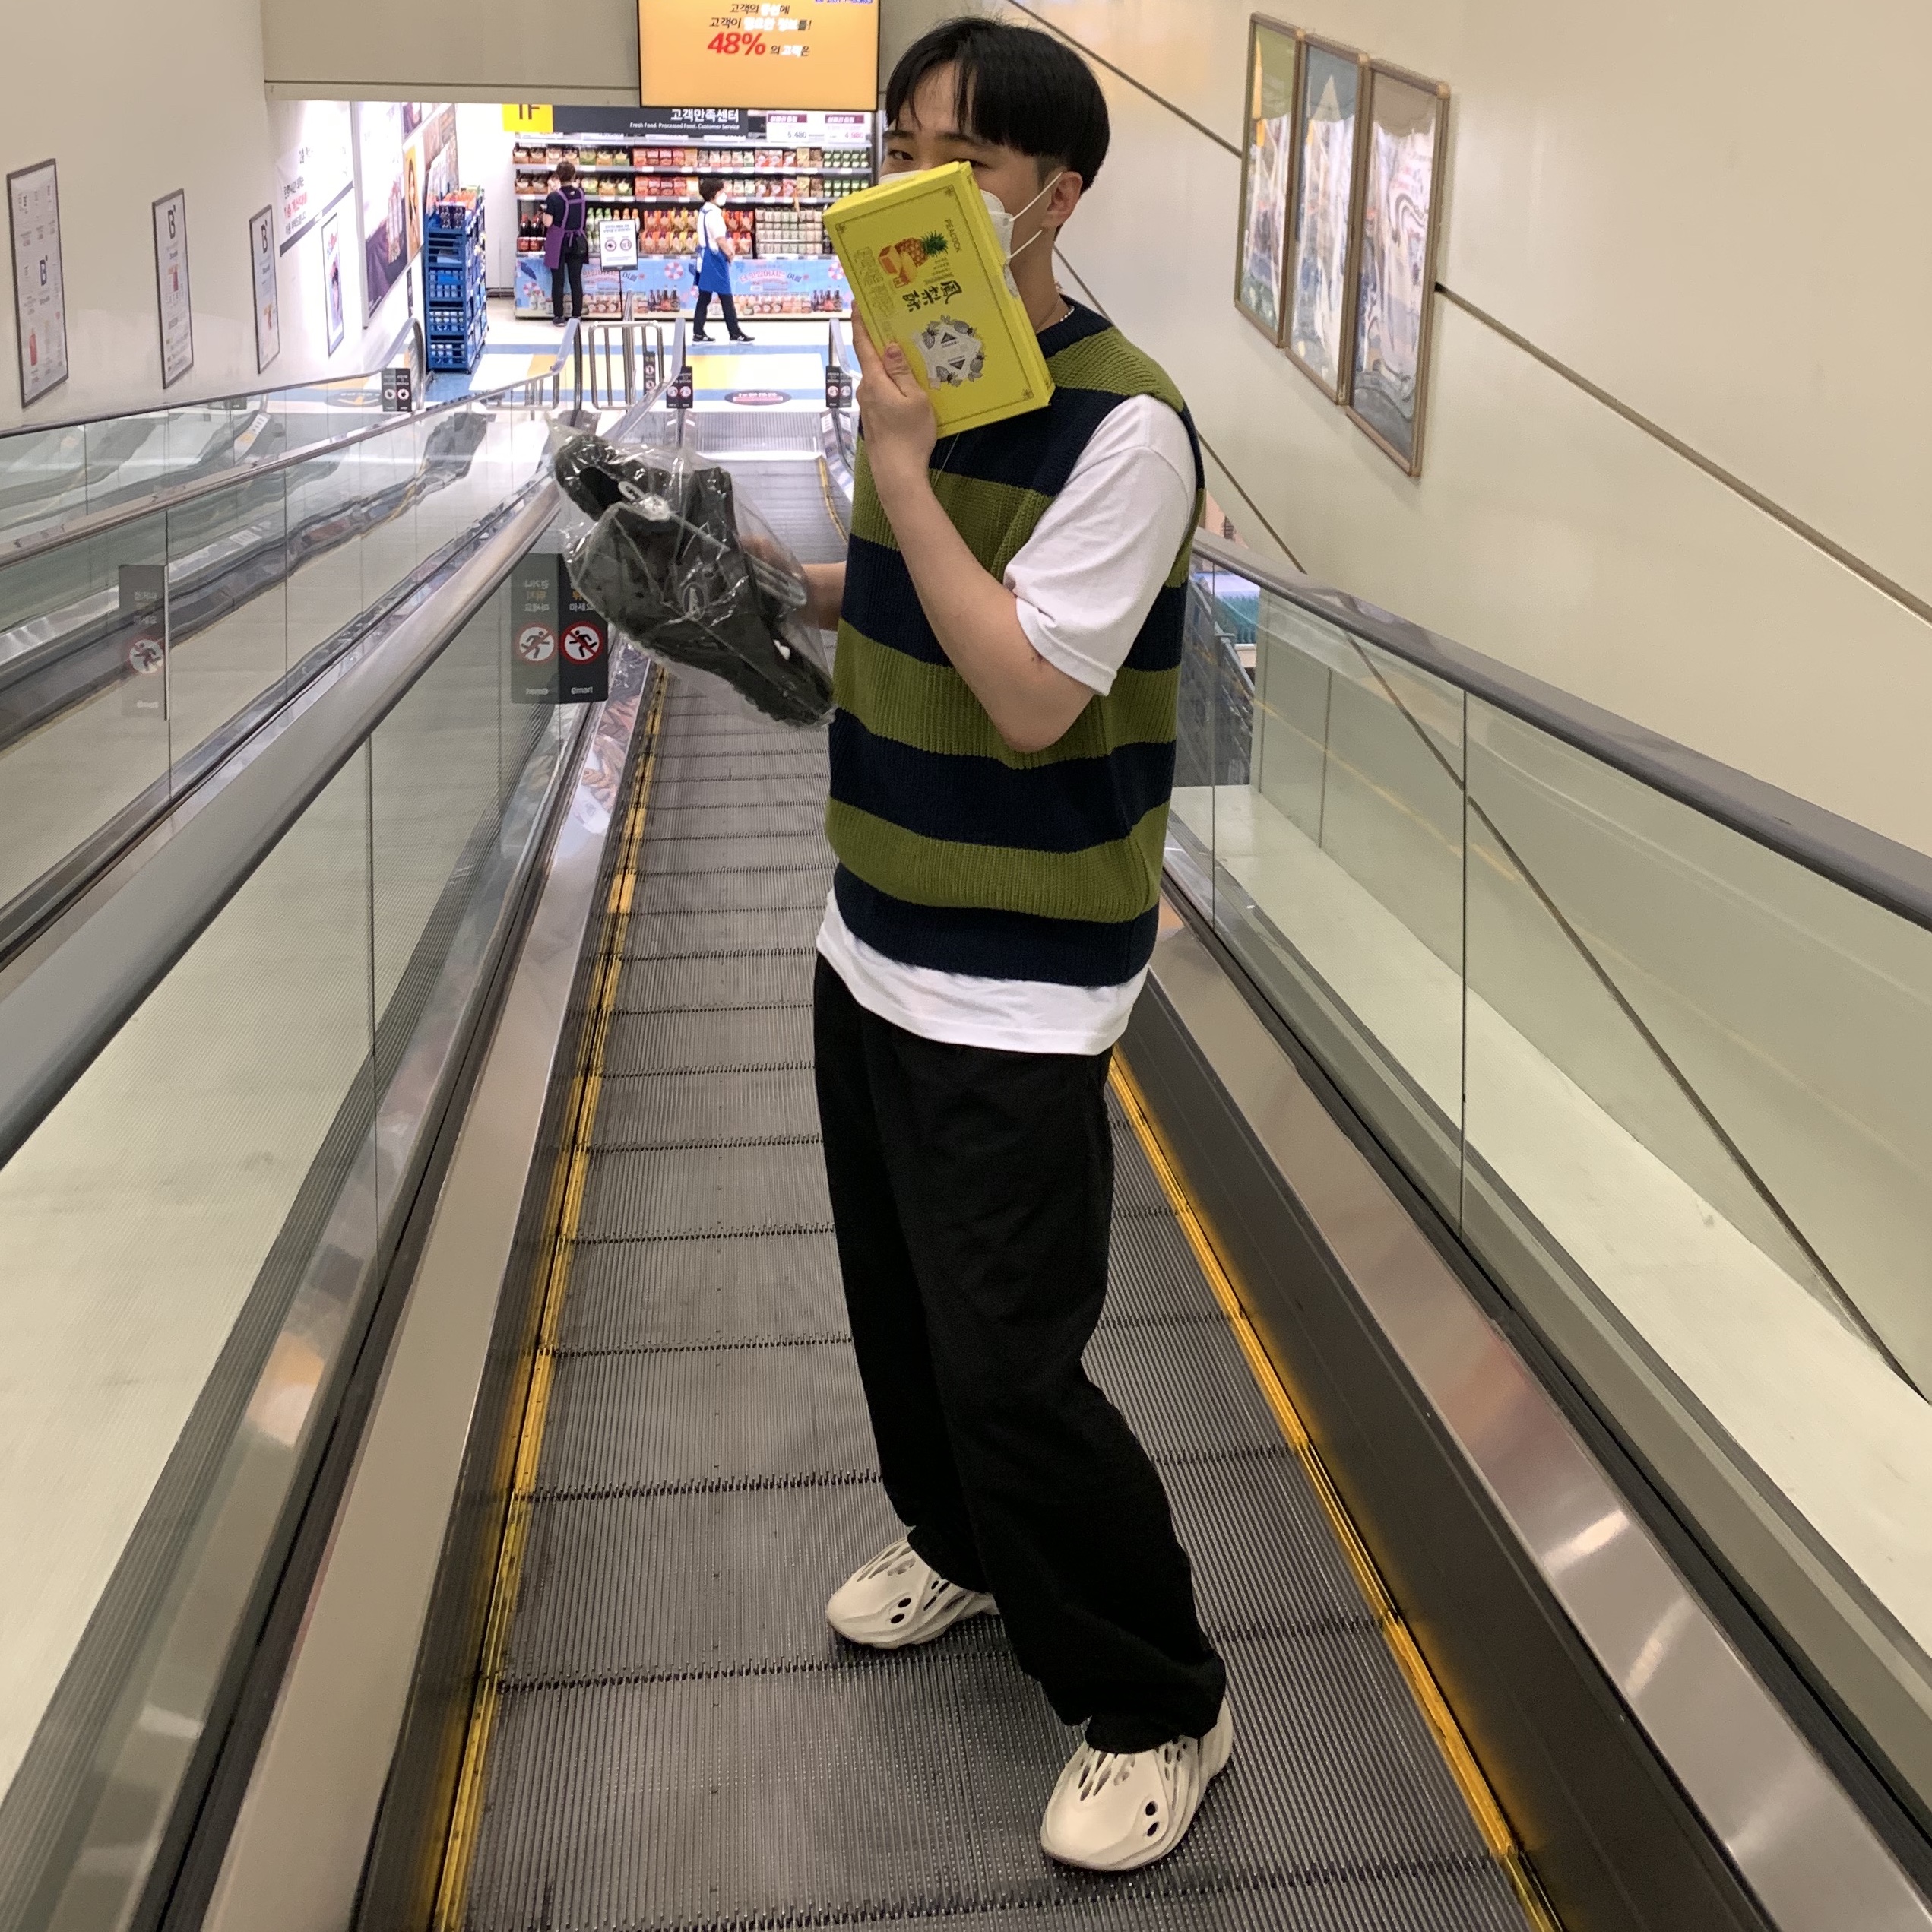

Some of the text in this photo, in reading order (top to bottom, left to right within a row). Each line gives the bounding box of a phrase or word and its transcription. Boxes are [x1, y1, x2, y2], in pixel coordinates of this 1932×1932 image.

[709, 17, 742, 29] 고객이
[707, 32, 766, 55] 48%
[670, 109, 739, 122] 고객만족센터
[944, 218, 962, 254] PEACOCK
